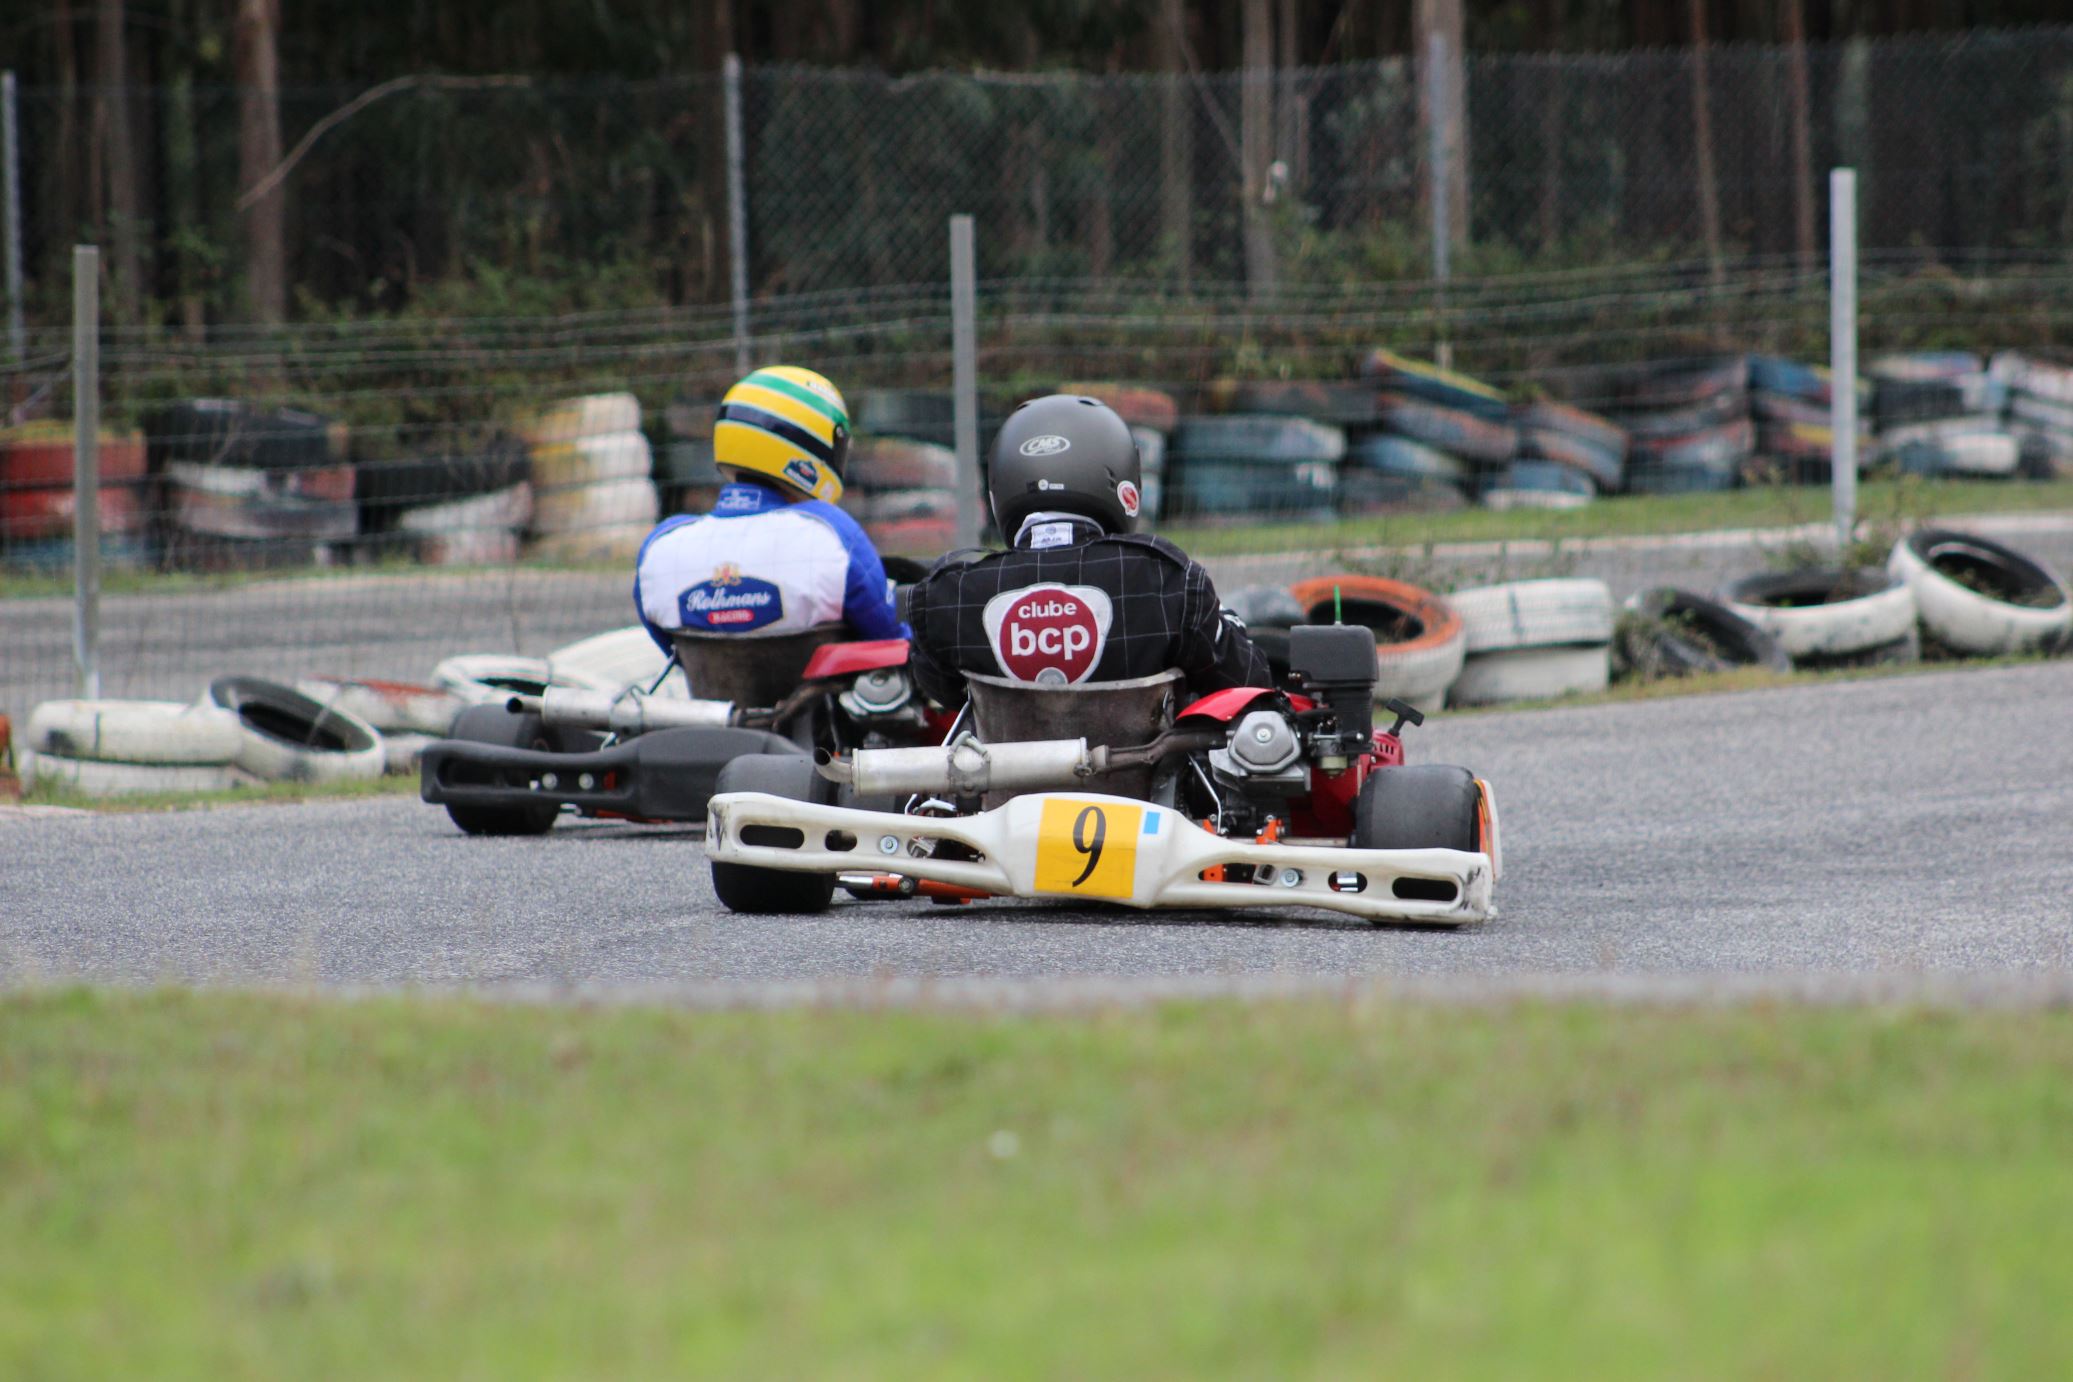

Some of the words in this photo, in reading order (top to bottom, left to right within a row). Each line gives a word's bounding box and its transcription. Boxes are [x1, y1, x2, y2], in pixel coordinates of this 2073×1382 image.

[687, 587, 771, 612] Rothmans
[1018, 600, 1077, 619] clube
[1011, 622, 1090, 660] bcp
[1072, 805, 1107, 887] 9
